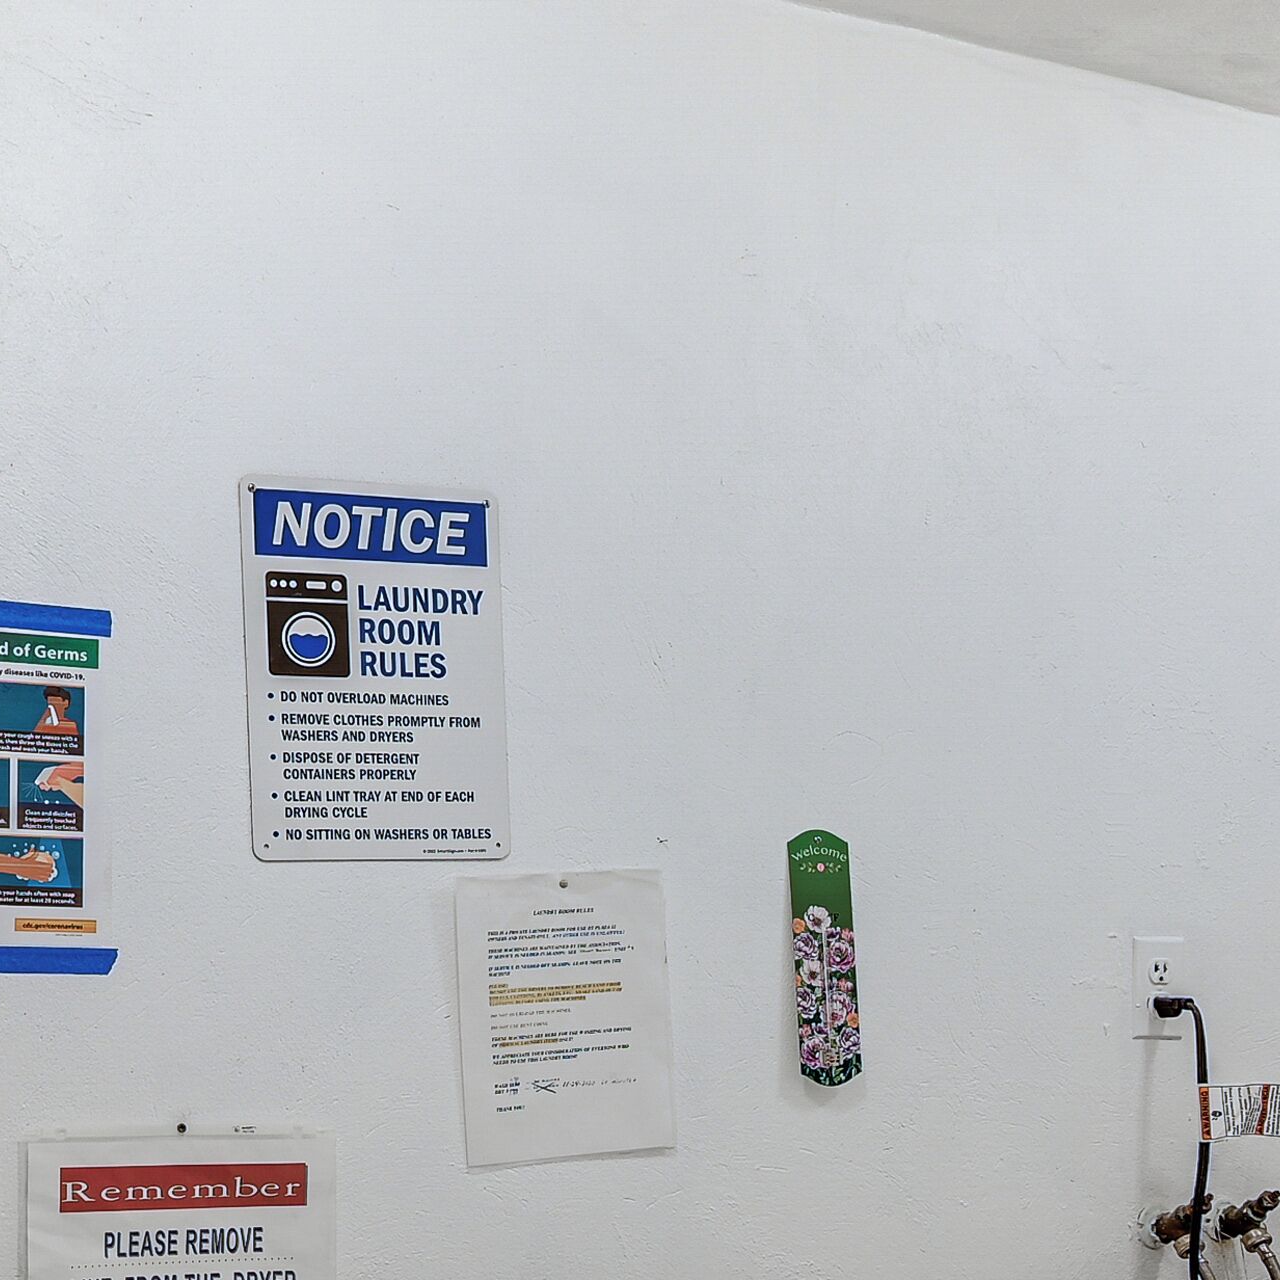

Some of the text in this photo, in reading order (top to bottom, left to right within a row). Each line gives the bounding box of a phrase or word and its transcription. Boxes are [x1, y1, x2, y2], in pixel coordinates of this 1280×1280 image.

[272, 501, 470, 555] NOTICE
[357, 585, 483, 616] LAUNDRY
[359, 618, 440, 645] ROOM
[13, 645, 31, 657] of
[34, 645, 88, 662] Germs
[360, 652, 447, 678] RULES
[4, 668, 34, 677] diseases
[50, 671, 85, 681] COVID-19.
[281, 691, 448, 706] DO NOT OVERLOAD MACHINES
[282, 714, 480, 728] REMOVE CLOTHES PROMPTLY FROM
[282, 730, 413, 742] WASHERS AND DRYERS
[283, 753, 419, 764] DISPOSE OF DETERGENT
[283, 769, 416, 780] CONTAINERS PROPERLY
[284, 791, 474, 802] CLEAN LINT TRAY AT END OF EACH
[285, 807, 367, 818] DRYING CYCLE
[286, 829, 491, 840] NO SITTING ON WASHERS OR TABLES
[791, 845, 847, 862] welcome
[61, 1176, 301, 1203] Remember
[104, 1227, 263, 1258] PLEASE REMOVE
